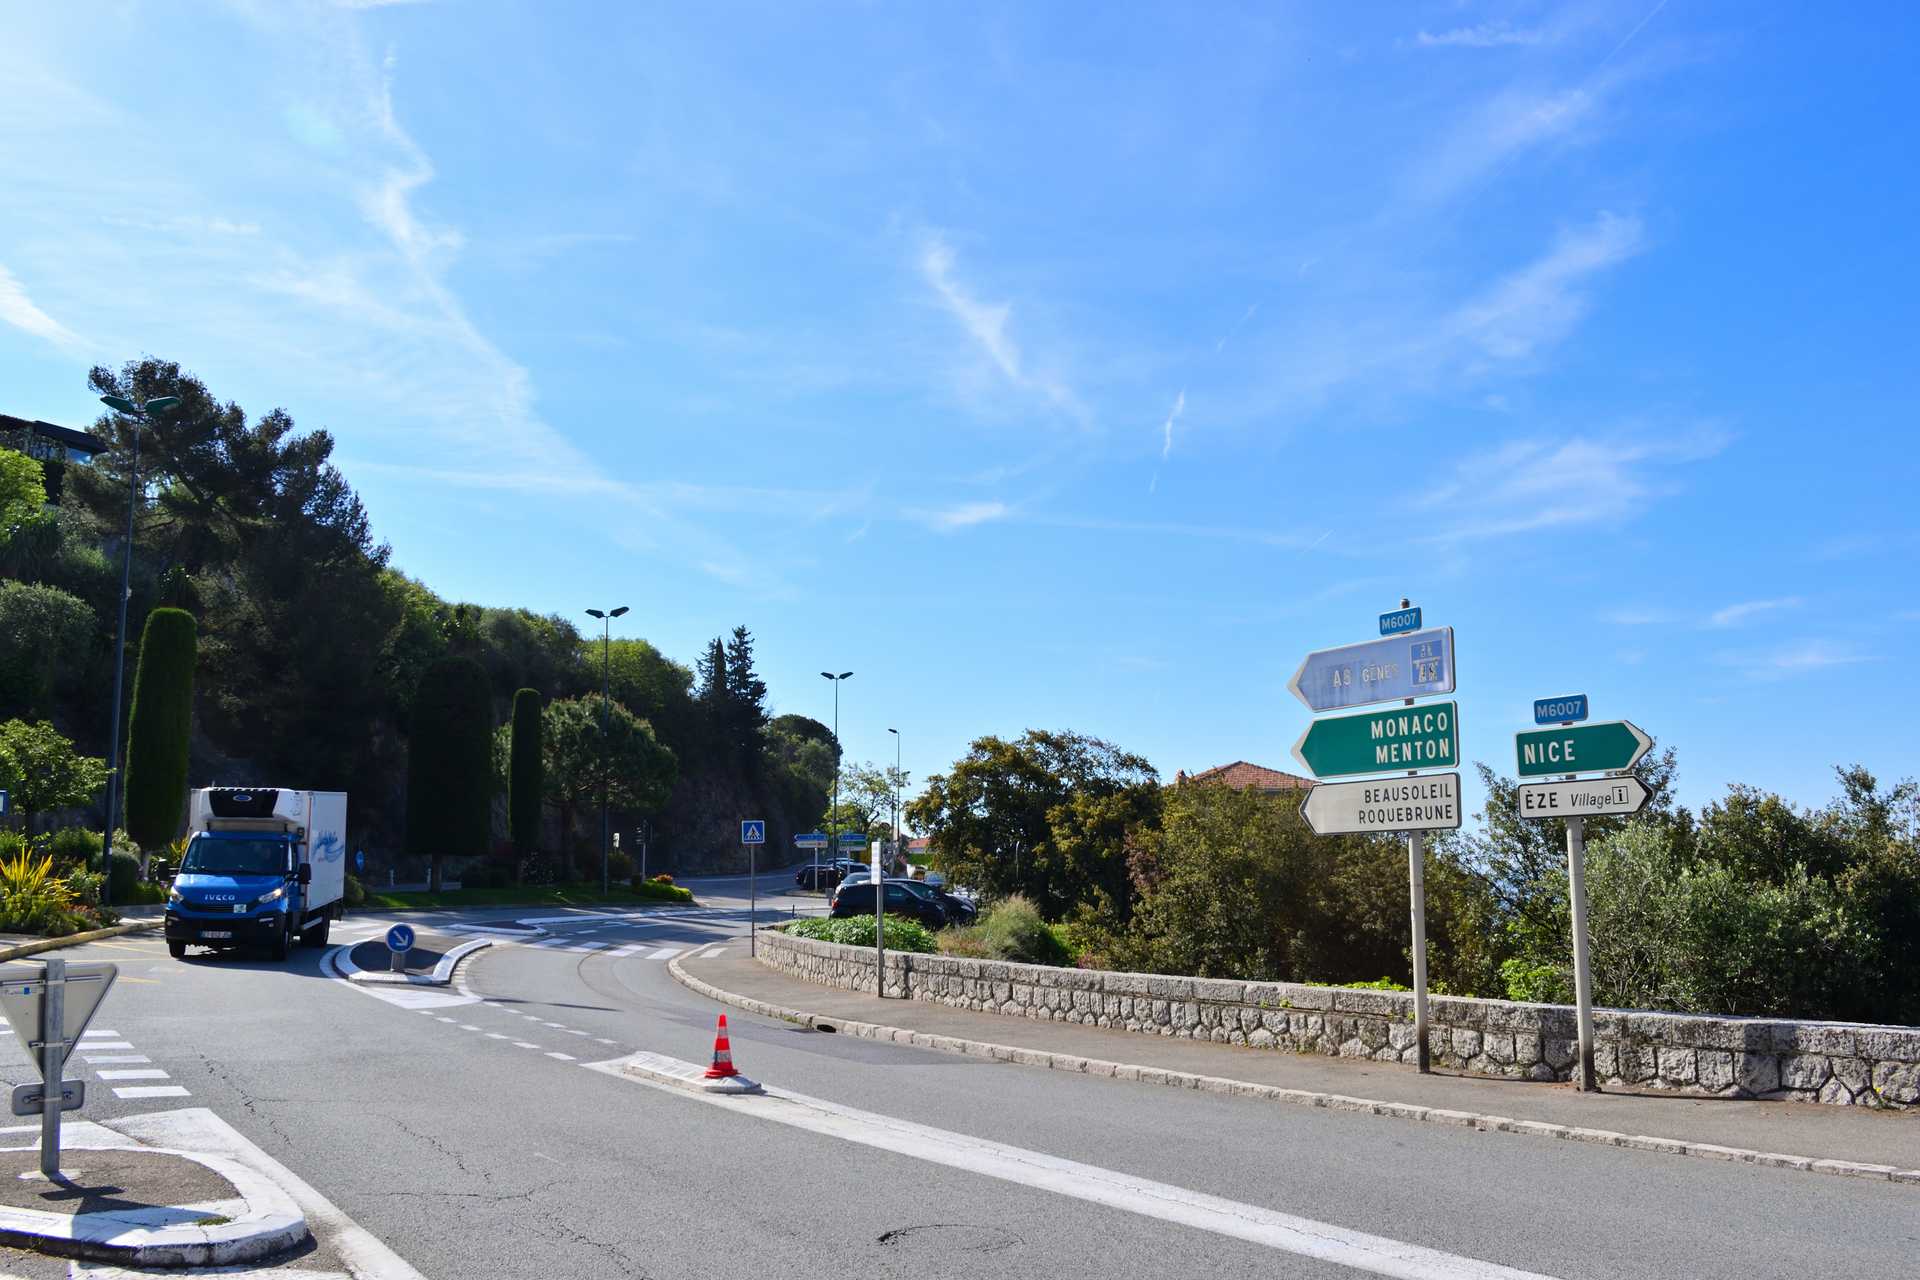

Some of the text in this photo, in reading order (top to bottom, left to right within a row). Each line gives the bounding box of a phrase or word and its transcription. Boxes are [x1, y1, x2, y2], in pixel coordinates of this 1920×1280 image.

[1381, 612, 1416, 631] M6007
[1536, 701, 1581, 718] M6007
[1371, 712, 1448, 739] MONACO
[1376, 738, 1449, 764] MENTON
[1524, 740, 1575, 765] NICE
[1364, 784, 1452, 803] BEAUSOLEIL
[1525, 790, 1558, 810] ÈZE
[1570, 792, 1611, 809] Village
[1358, 805, 1453, 824] ROQUEBRUNE
